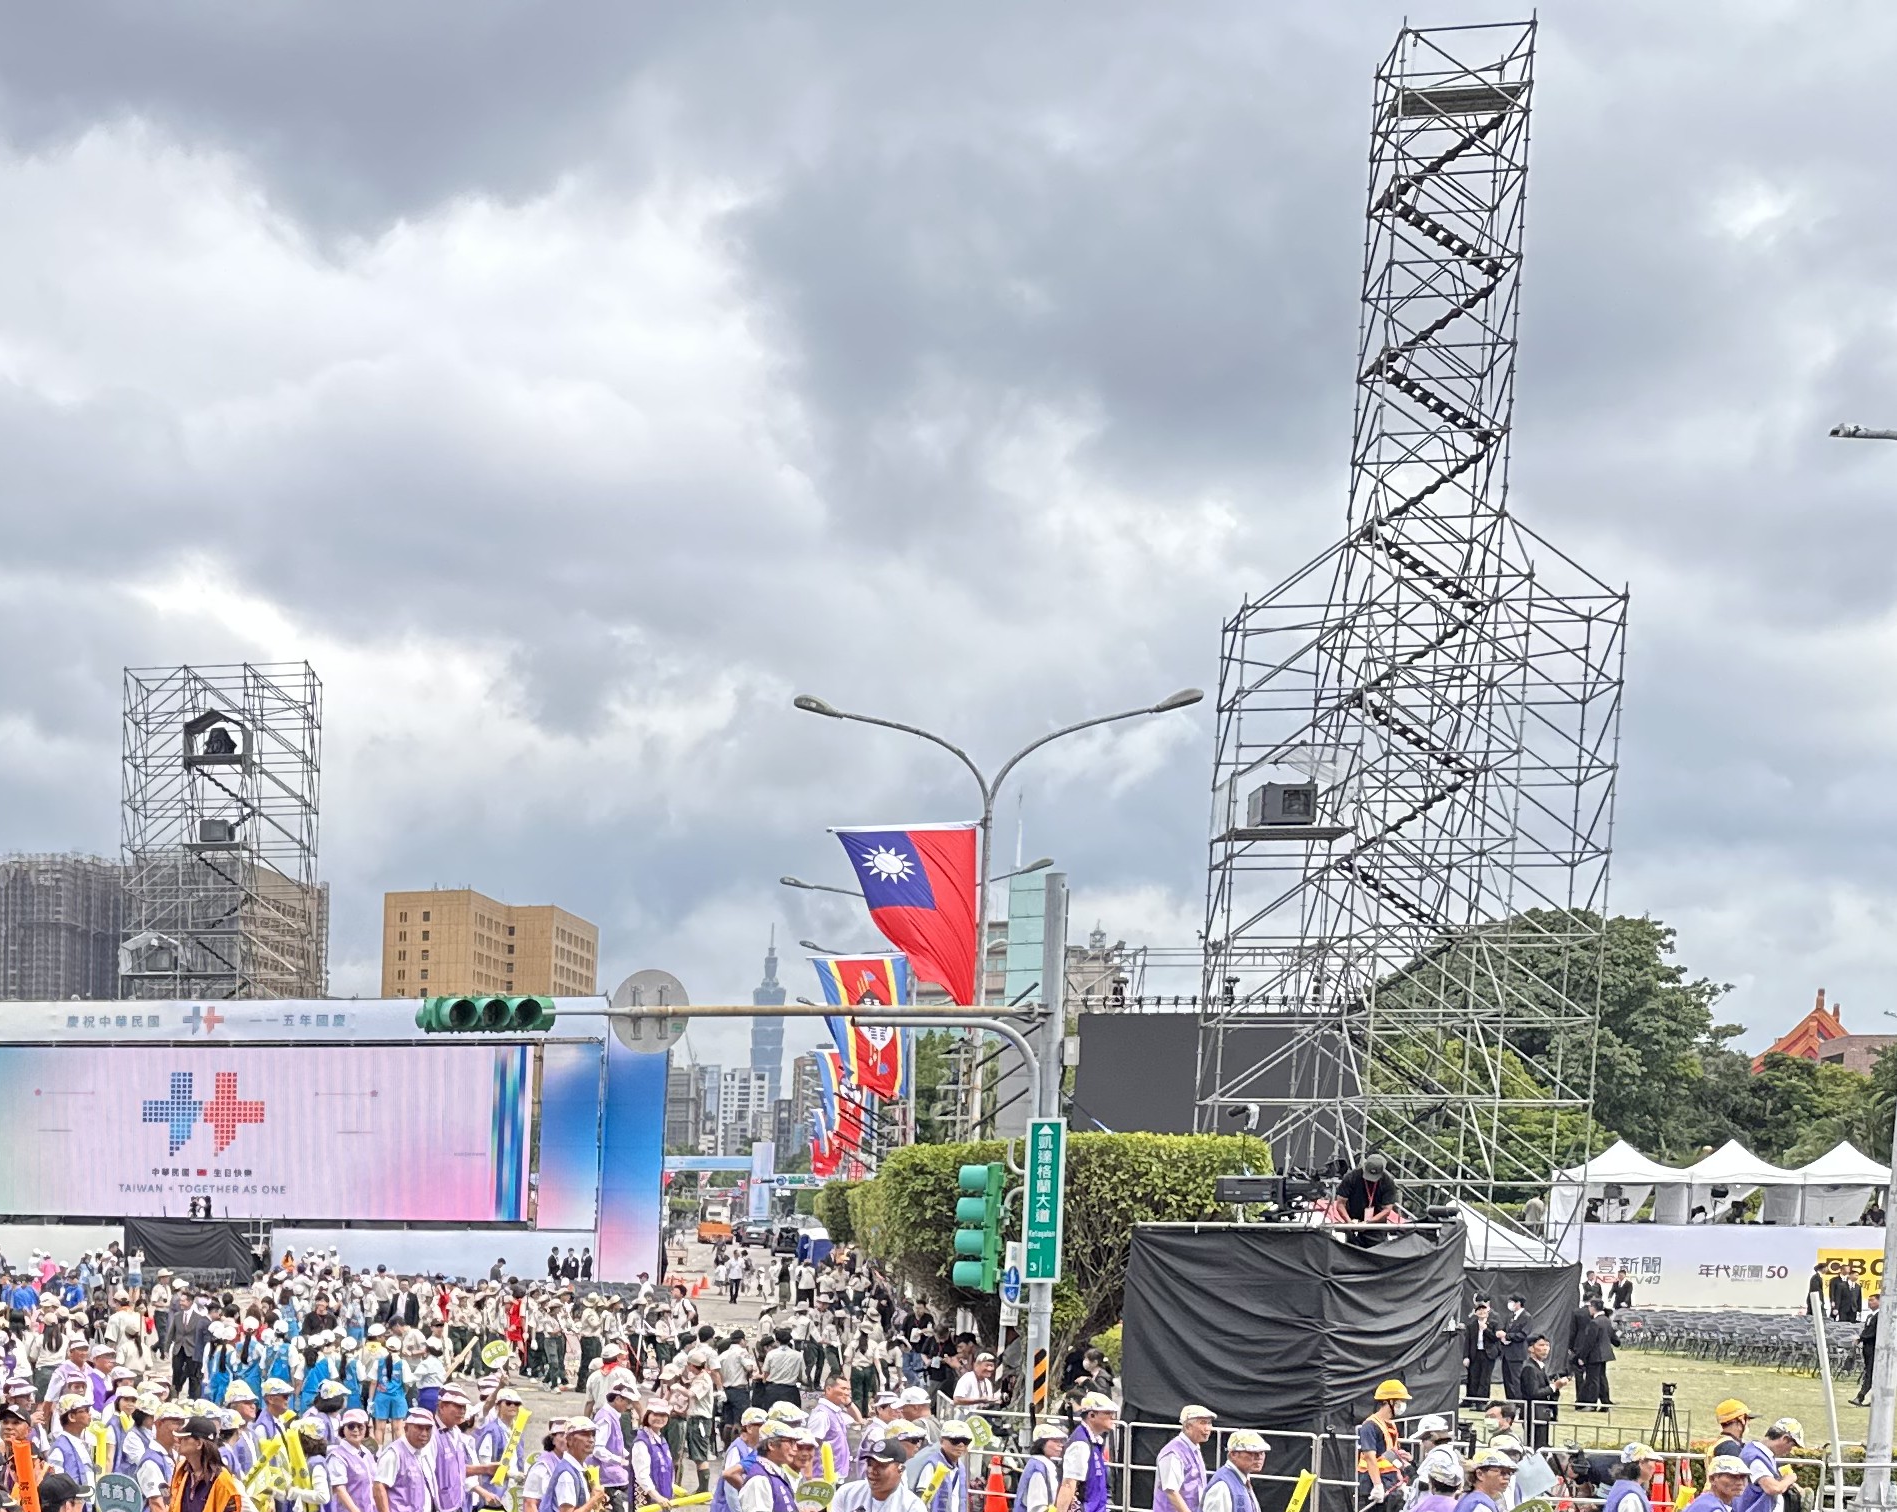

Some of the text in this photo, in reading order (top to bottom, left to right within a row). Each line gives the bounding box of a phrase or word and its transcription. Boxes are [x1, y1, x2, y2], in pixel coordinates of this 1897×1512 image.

[66, 1014, 346, 1028] 慶祝中華民國 一一五年國慶
[152, 1168, 252, 1177] 中華民國 生日快樂
[1035, 1135, 1053, 1223] 凱達格蘭大道
[119, 1184, 287, 1194] TAIWAN TOGETHER AS ONE
[1596, 1256, 1661, 1274] 壹新聞
[1698, 1264, 1789, 1278] 年代新聞 50
[100, 1482, 136, 1503] 青商會
